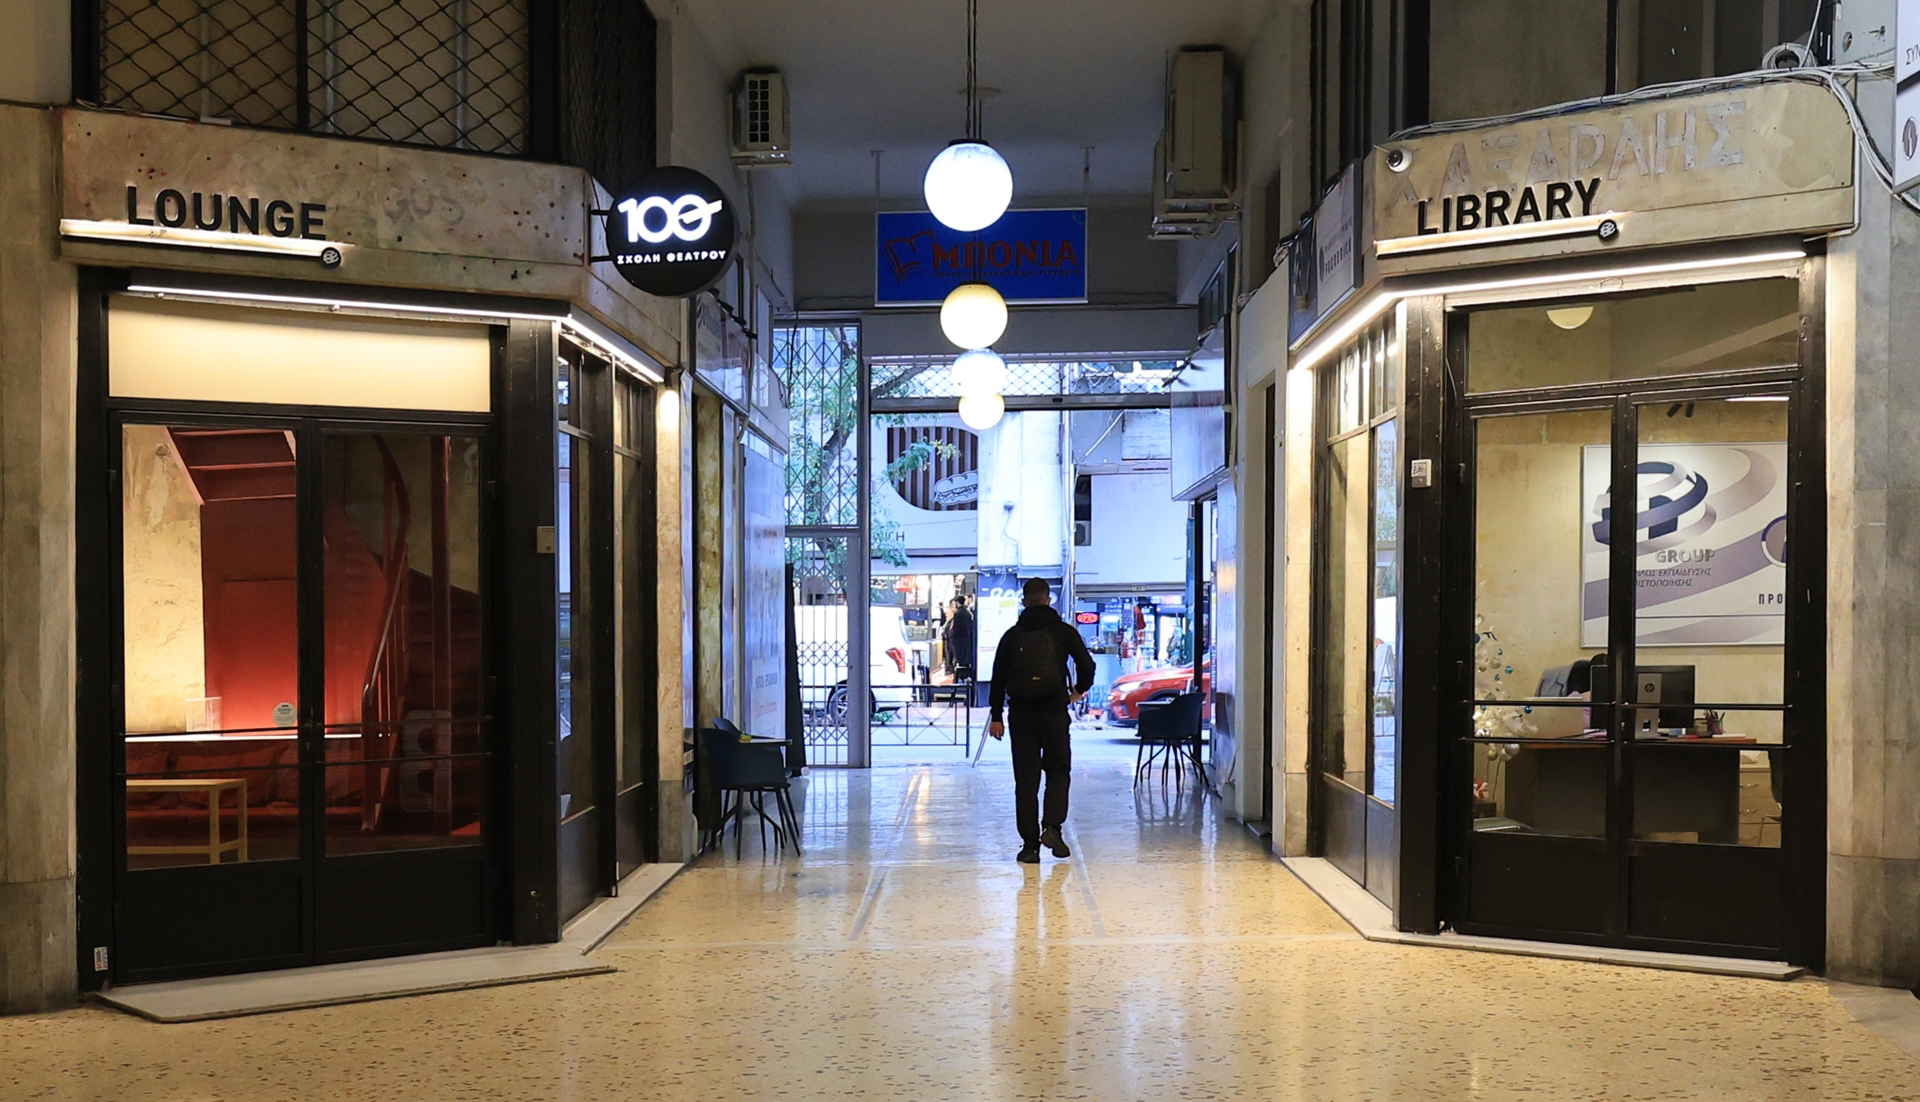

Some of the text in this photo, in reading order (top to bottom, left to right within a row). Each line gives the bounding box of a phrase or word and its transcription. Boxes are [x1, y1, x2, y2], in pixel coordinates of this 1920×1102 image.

[127, 185, 327, 240] LOUNGE
[617, 194, 723, 243] 100
[1417, 177, 1602, 236] LIBRARY
[617, 250, 726, 265] ΣΧΟΛΗ ΘΕΑΤΡΟΥ
[931, 240, 1079, 270] ΜΠΟΝΙΑ
[1655, 549, 1716, 563] GROUP
[1658, 568, 1712, 577] ΕΚΠΑΙΔΕΥΣΗΣ
